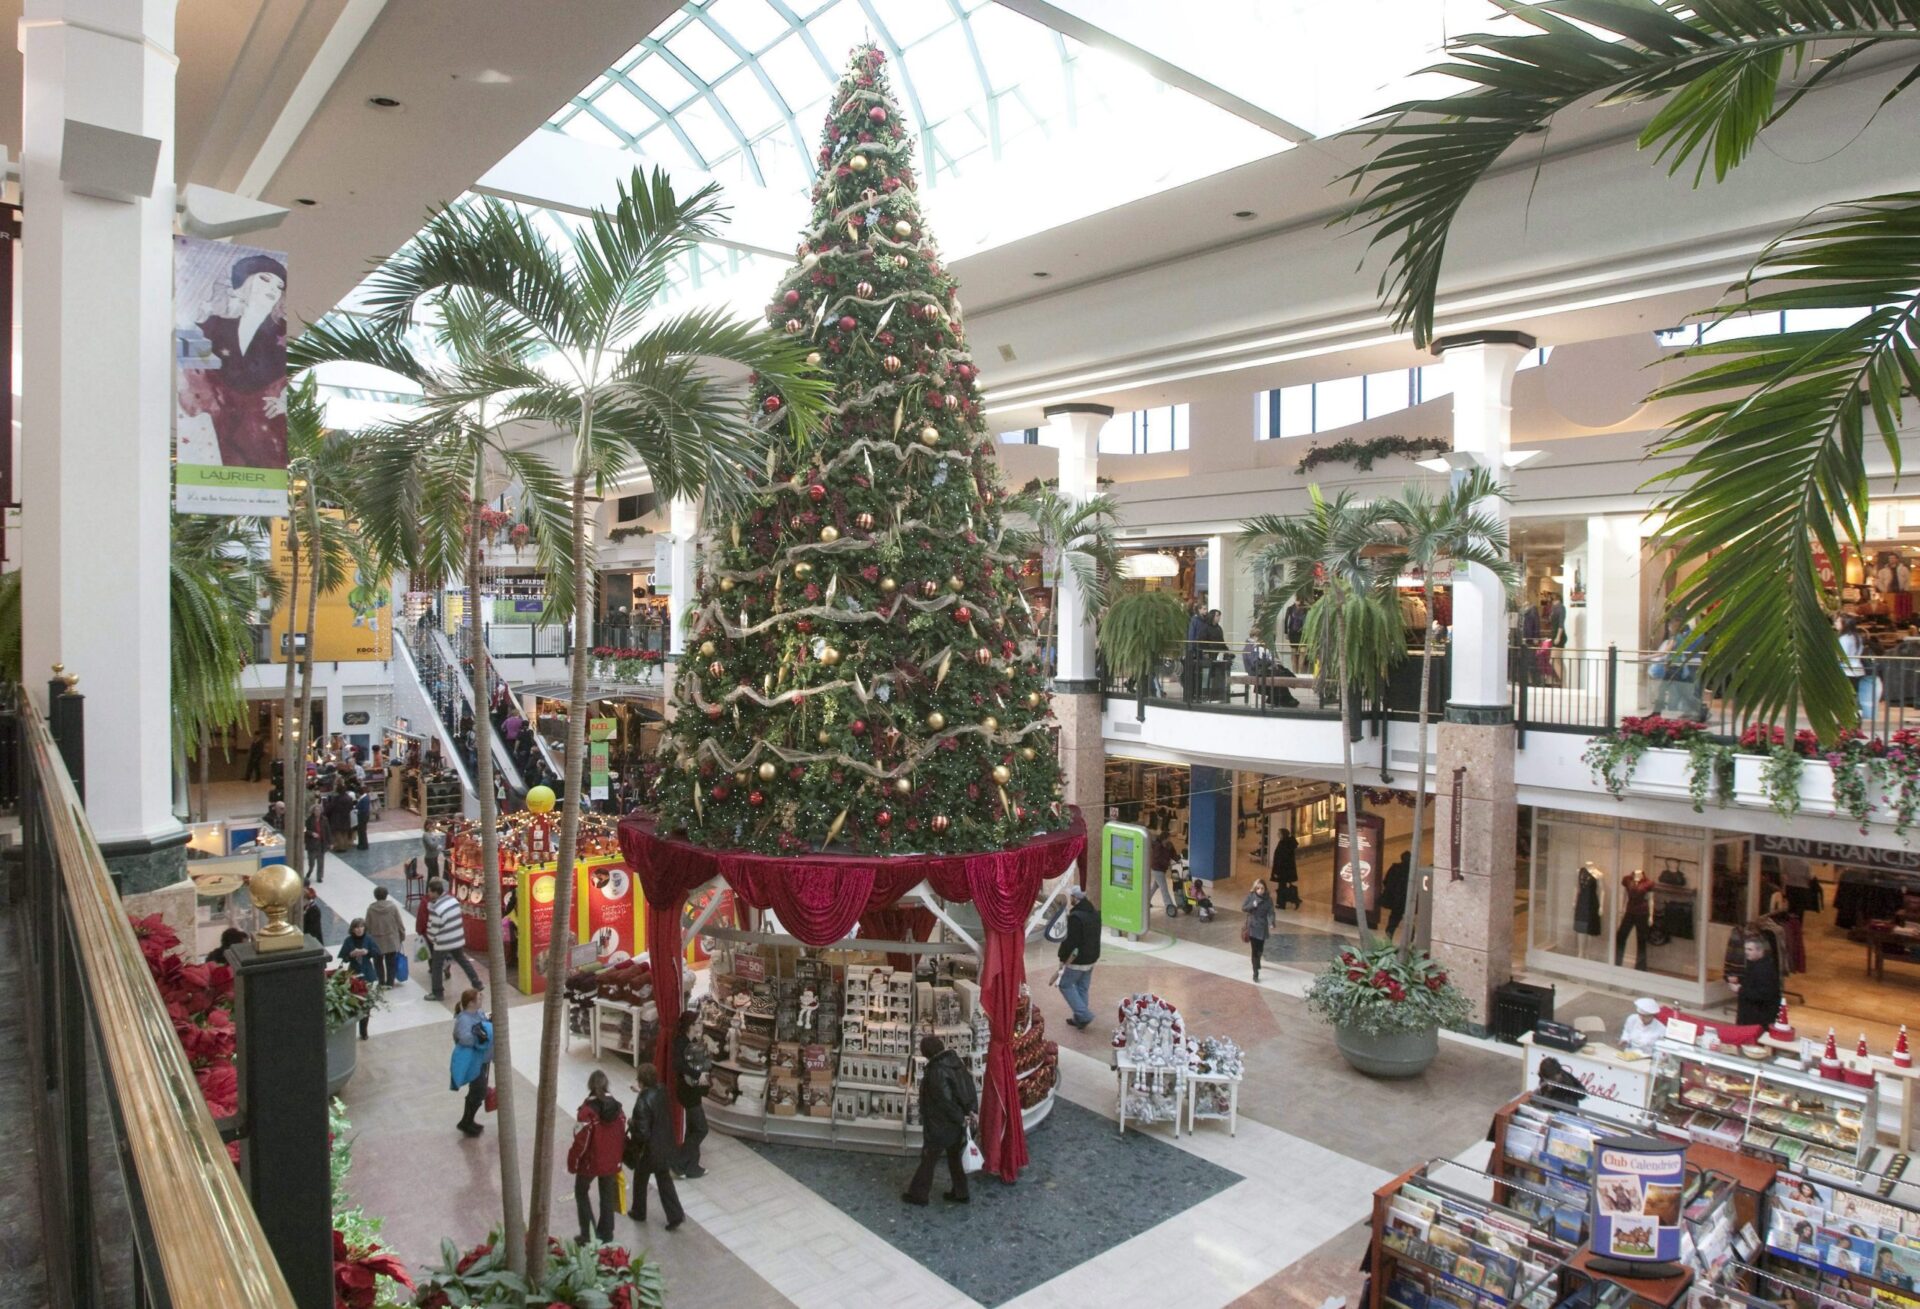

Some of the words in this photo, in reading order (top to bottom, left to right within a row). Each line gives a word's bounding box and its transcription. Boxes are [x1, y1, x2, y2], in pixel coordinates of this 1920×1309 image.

[200, 470, 266, 482] LAURIER
[1763, 834, 1810, 853] SAN
[1816, 841, 1920, 868] FRANCIS
[1603, 1154, 1628, 1168] Club
[1630, 1159, 1680, 1171] Calendrier
